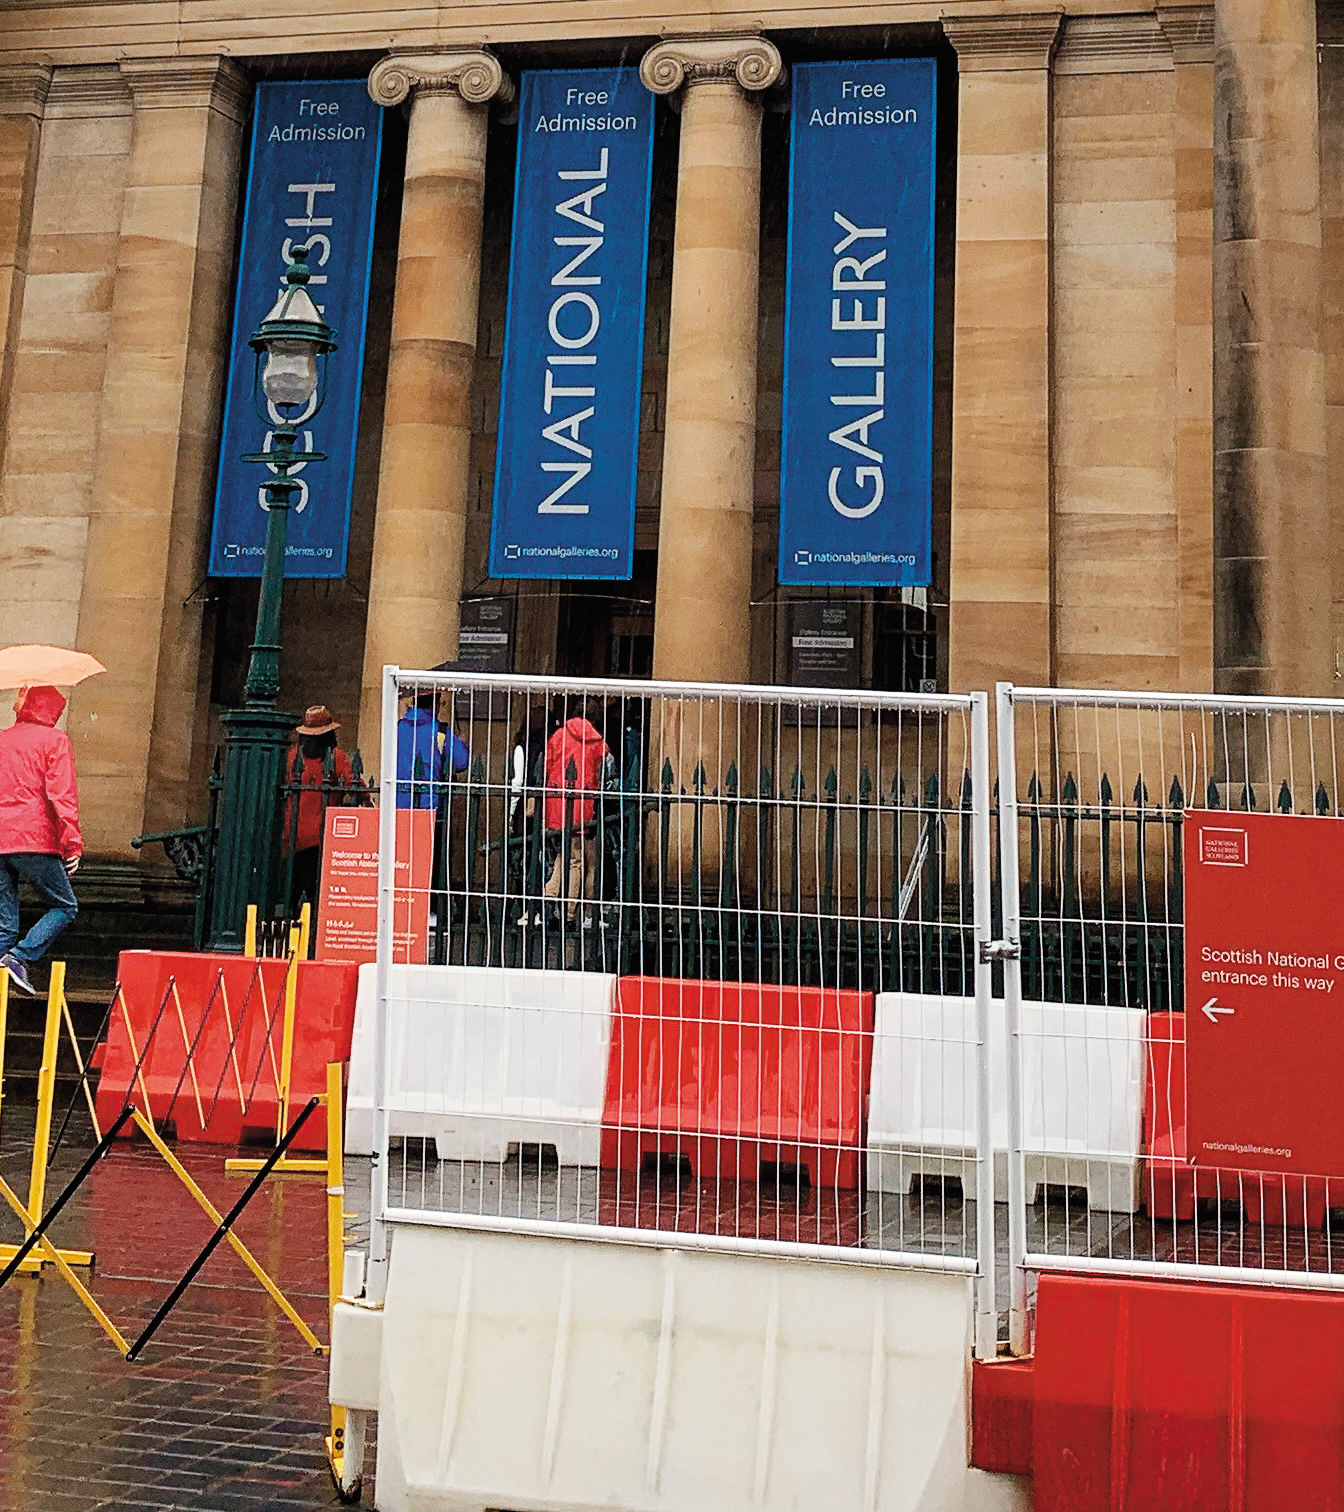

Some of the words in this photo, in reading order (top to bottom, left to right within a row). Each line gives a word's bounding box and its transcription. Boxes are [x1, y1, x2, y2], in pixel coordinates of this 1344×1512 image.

[566, 88, 608, 105] Free
[842, 80, 886, 98] Free
[299, 99, 340, 116] Free
[808, 105, 917, 126] Admission
[534, 113, 637, 132] Admission
[267, 123, 366, 142] Admission
[537, 147, 609, 515] NATIONAL
[827, 210, 888, 519] GALLERY
[522, 545, 619, 560] nationalgalleries.org
[813, 551, 916, 566] nationalgalleries.org
[331, 850, 363, 860] Welcome
[364, 851, 371, 859] to
[331, 859, 358, 868] Scottish
[358, 860, 379, 869] Nation
[1201, 946, 1263, 965] Scottish
[1267, 951, 1330, 970] National
[1201, 970, 1268, 986] entrance
[1272, 972, 1300, 989] this
[1304, 977, 1335, 993] way
[1202, 1141, 1292, 1158] nationalgalleries.org
